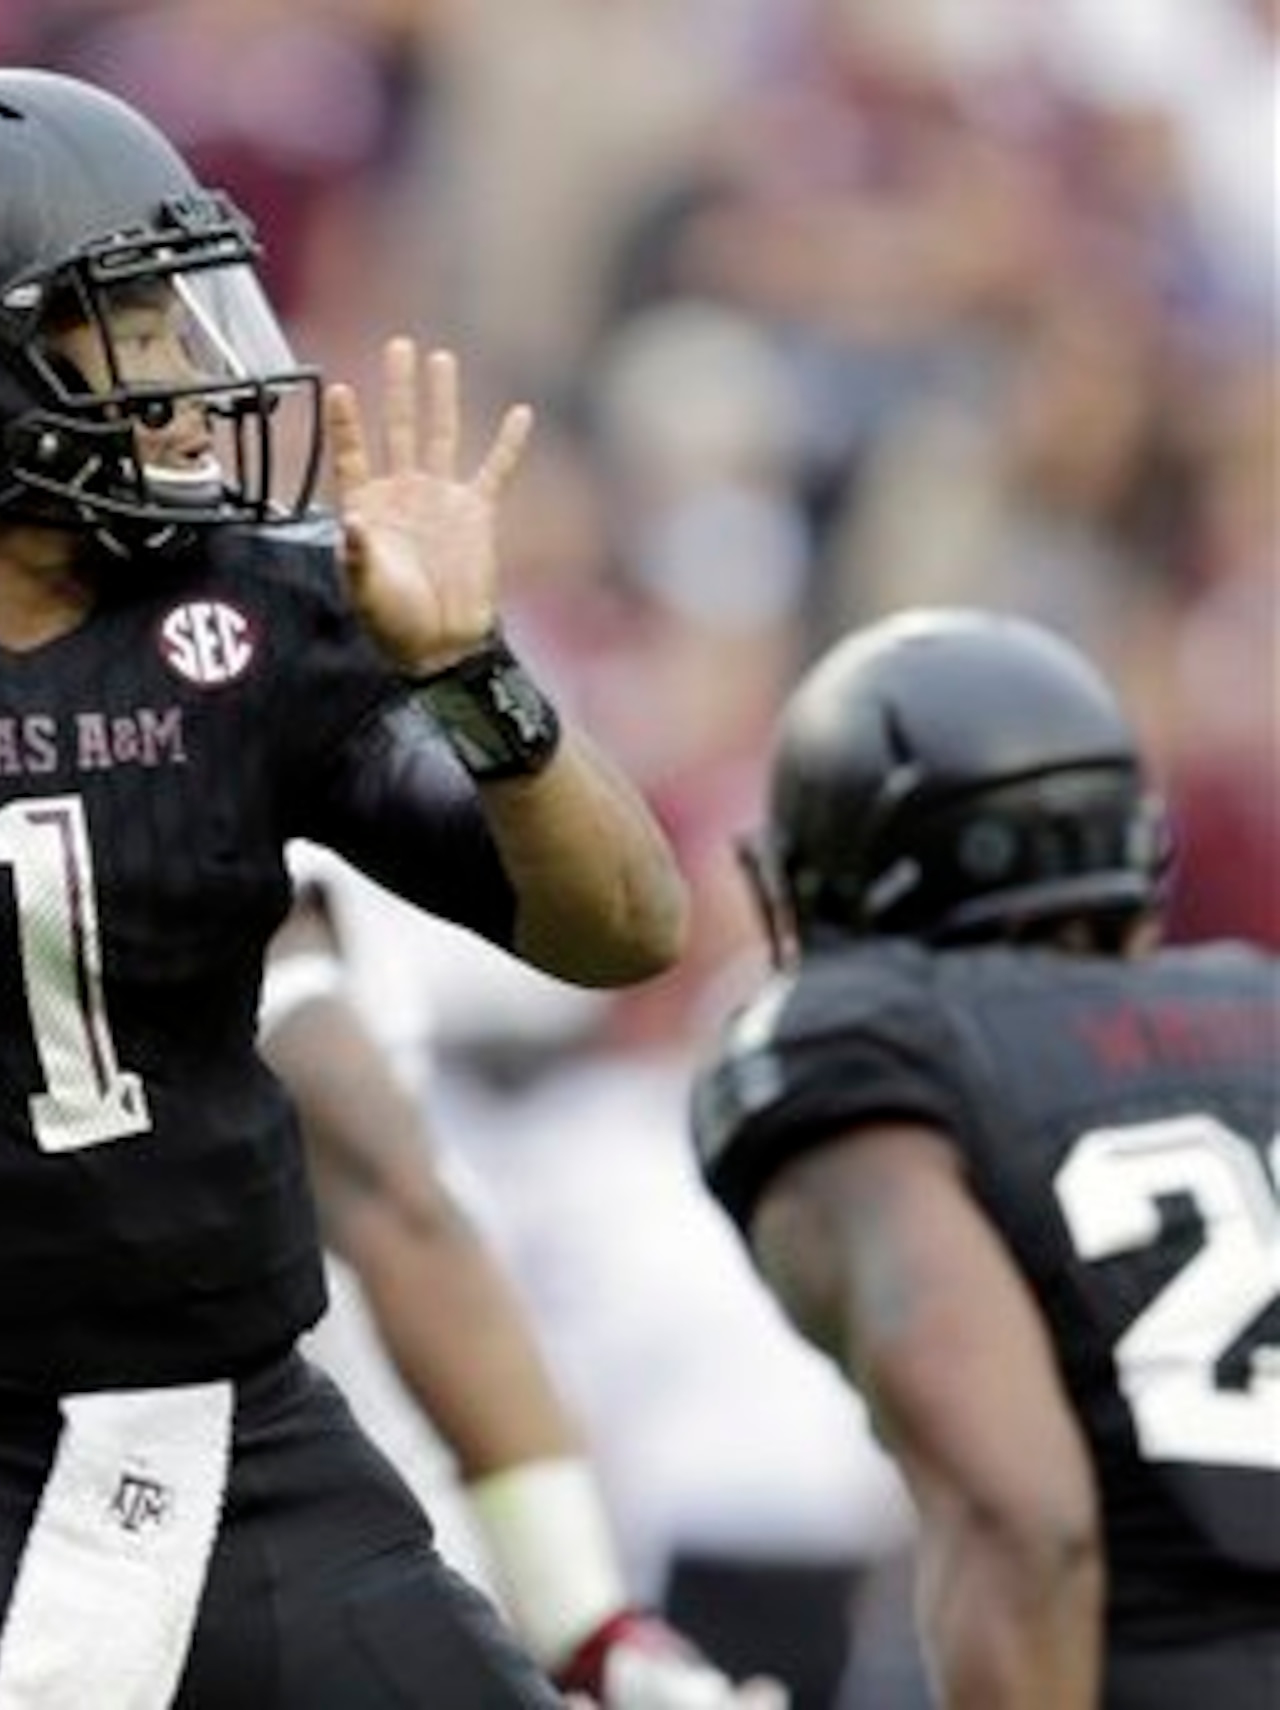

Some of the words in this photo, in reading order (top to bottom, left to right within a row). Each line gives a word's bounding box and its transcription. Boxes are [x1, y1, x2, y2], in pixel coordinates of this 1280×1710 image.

[161, 601, 254, 682] SEC
[76, 708, 186, 768] A&M
[1054, 1112, 1280, 1468] 2
